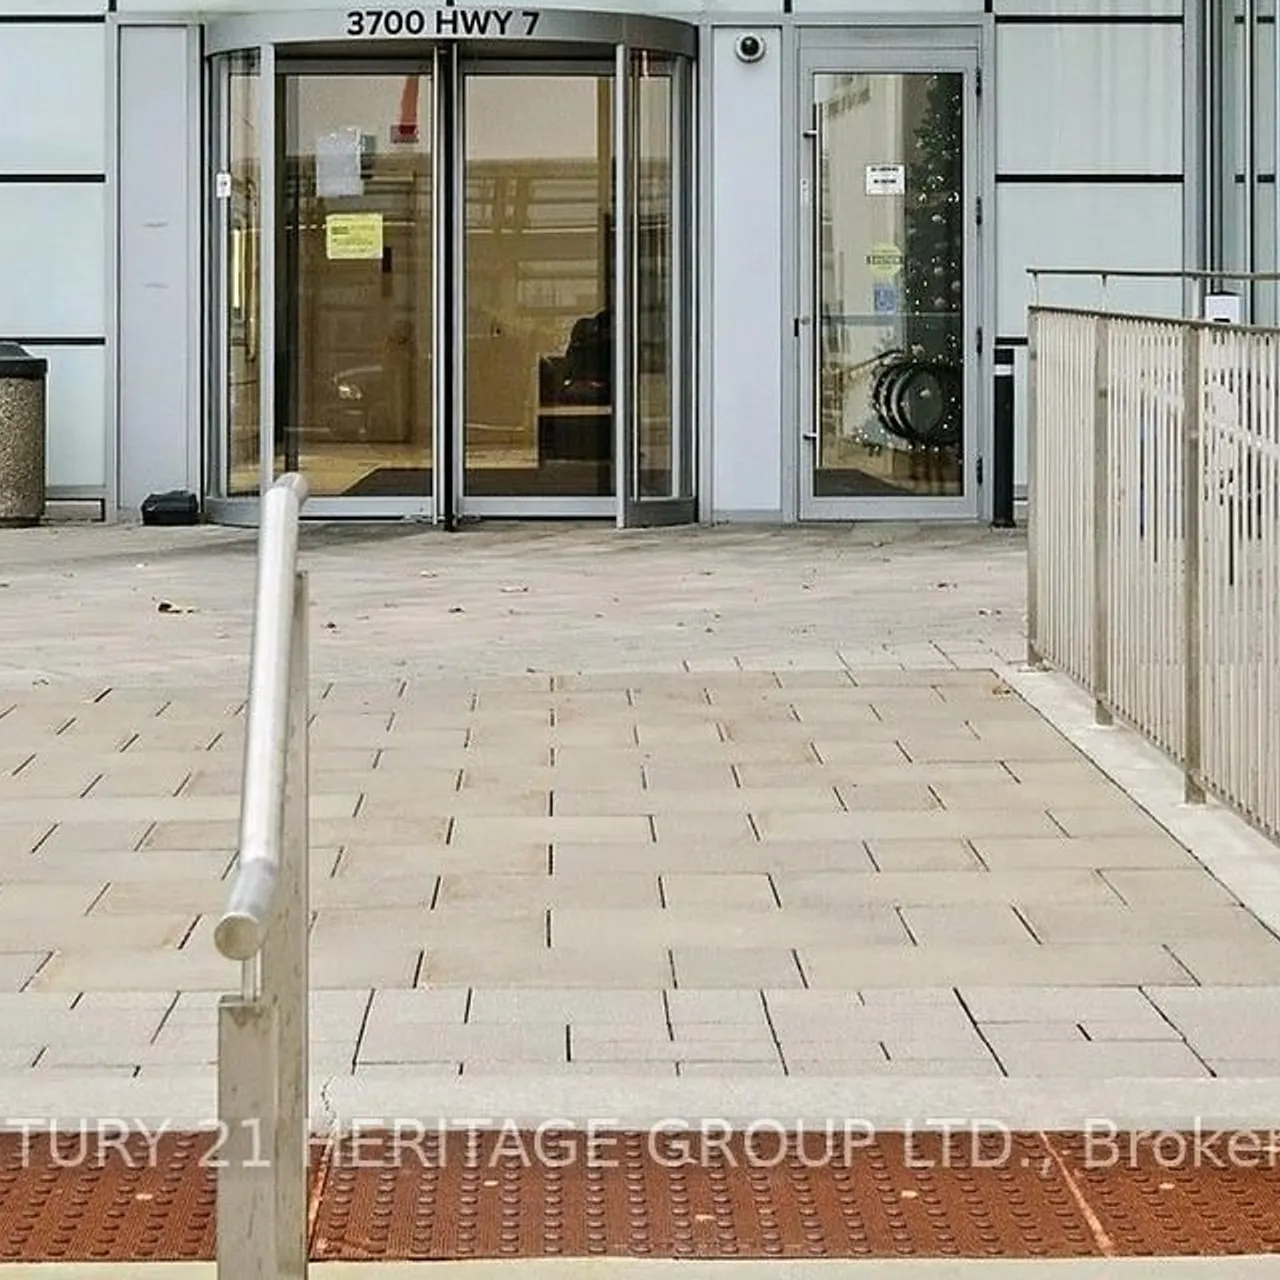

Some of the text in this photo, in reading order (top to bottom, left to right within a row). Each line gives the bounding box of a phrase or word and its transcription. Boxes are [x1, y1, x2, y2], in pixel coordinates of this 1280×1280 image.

[347, 10, 540, 36] 3700 HWY 7
